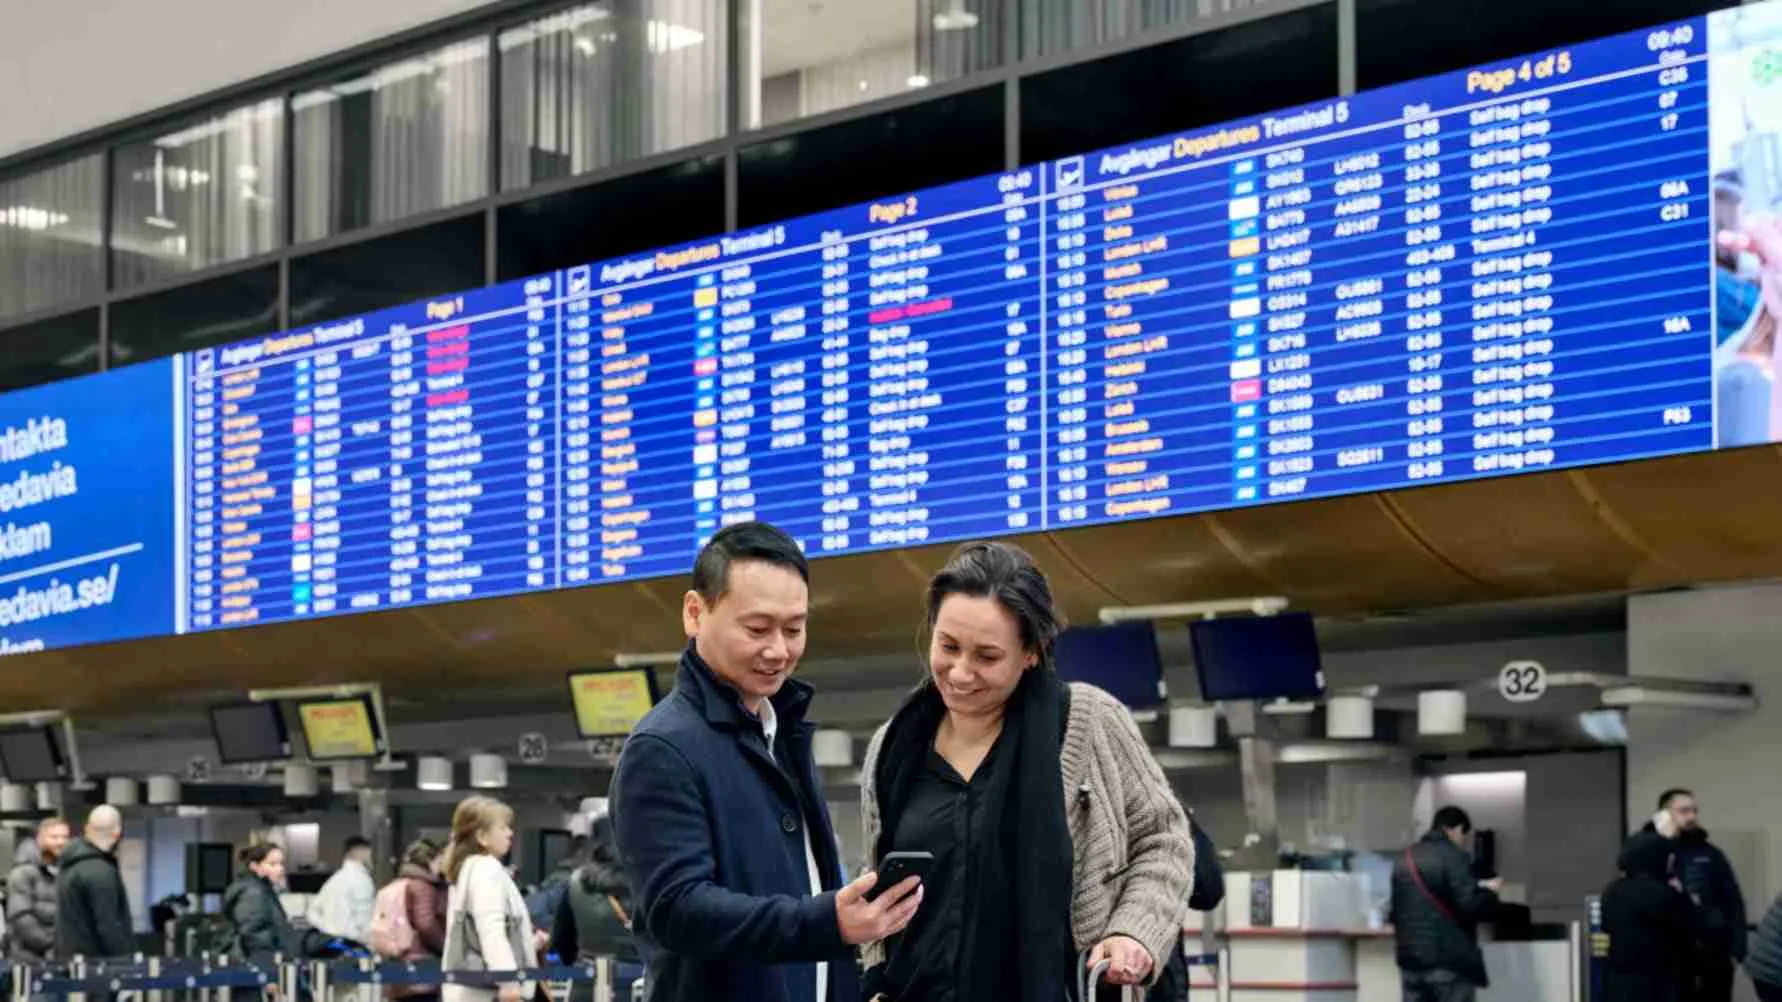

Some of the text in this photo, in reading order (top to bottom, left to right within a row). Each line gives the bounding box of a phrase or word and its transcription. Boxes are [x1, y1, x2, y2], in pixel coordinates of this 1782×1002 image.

[1467, 52, 1570, 92] Page 4 of 5
[1173, 125, 1259, 157] Departures
[1262, 106, 1333, 137] Terminal
[1335, 101, 1348, 122] 5
[906, 196, 916, 214] 2
[1506, 667, 1539, 694] 32
